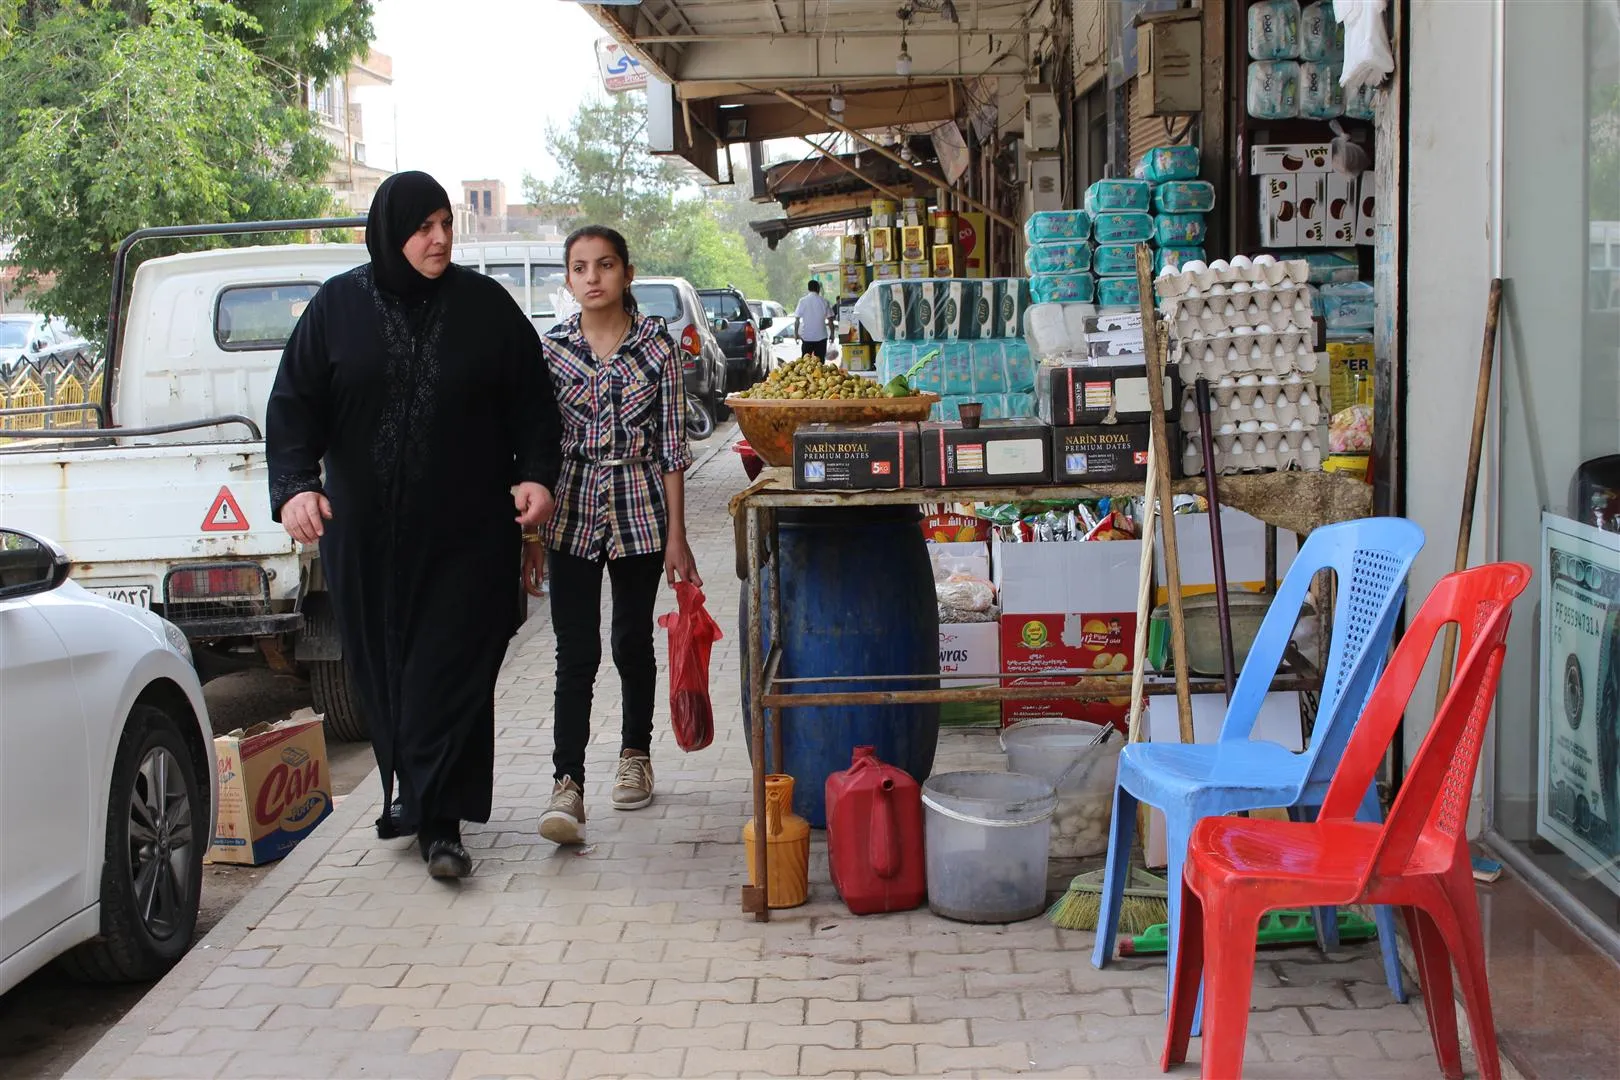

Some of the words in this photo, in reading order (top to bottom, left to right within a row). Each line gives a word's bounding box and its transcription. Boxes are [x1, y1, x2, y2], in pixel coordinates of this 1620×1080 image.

[1099, 434, 1129, 443] ROYAL
[838, 443, 869, 452] ROYAL
[255, 759, 319, 826] Can
